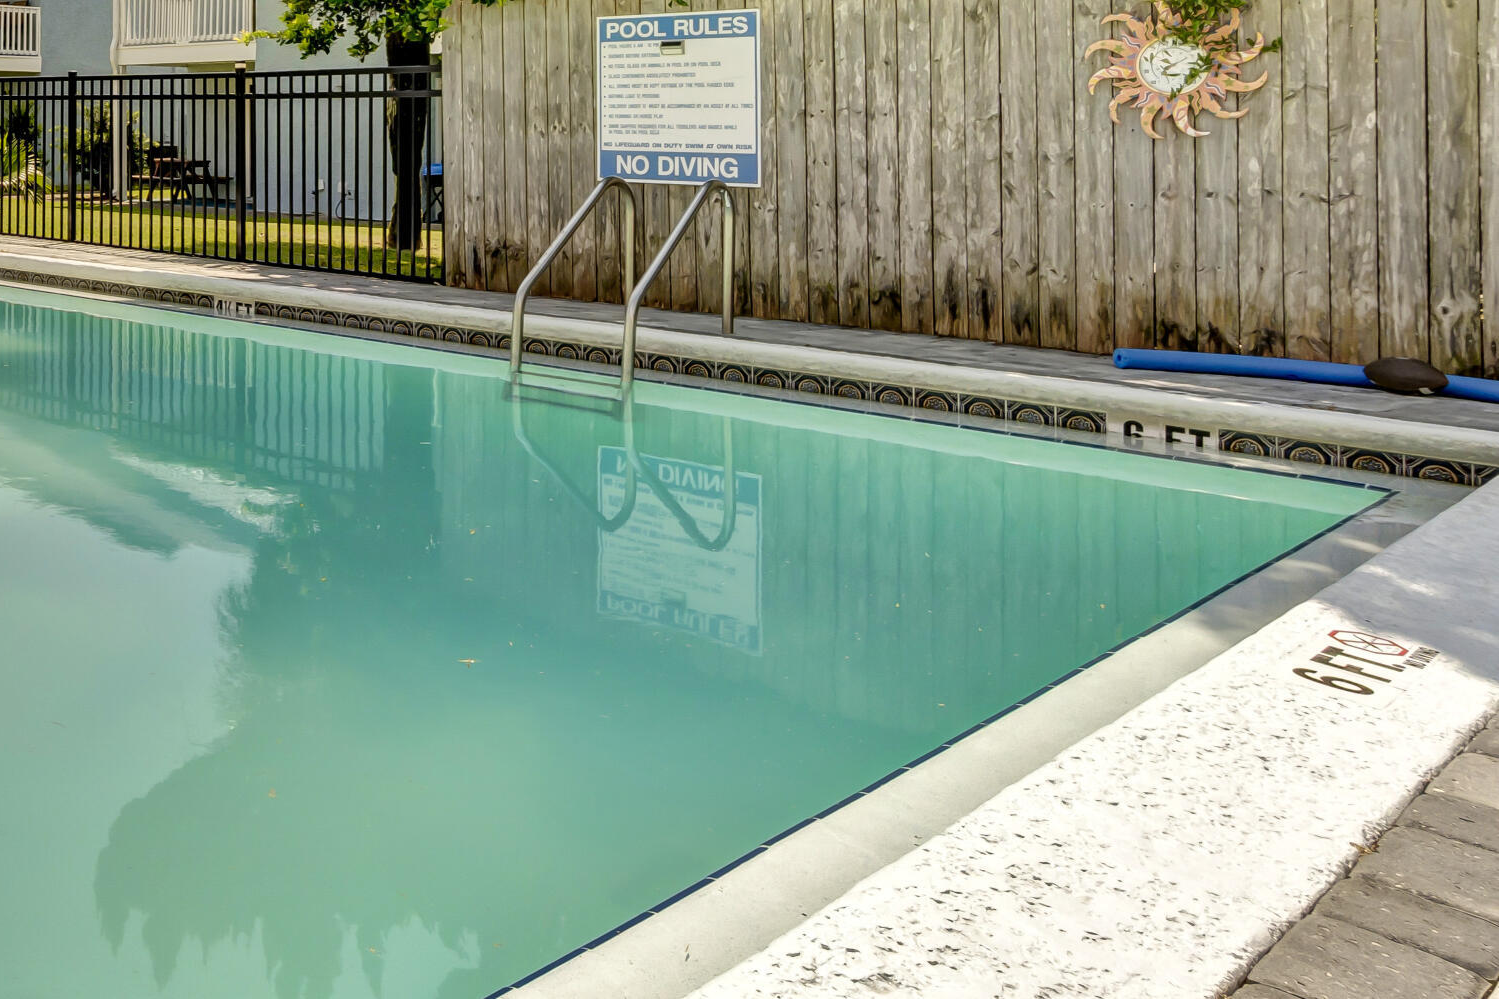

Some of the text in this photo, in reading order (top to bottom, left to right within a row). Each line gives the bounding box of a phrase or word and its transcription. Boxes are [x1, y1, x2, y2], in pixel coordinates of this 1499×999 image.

[606, 16, 748, 39] POOL RULES
[616, 155, 738, 178] NO DIVING
[236, 301, 252, 314] FT
[1123, 420, 1210, 447] 6 FT
[1292, 667, 1374, 695] 6
